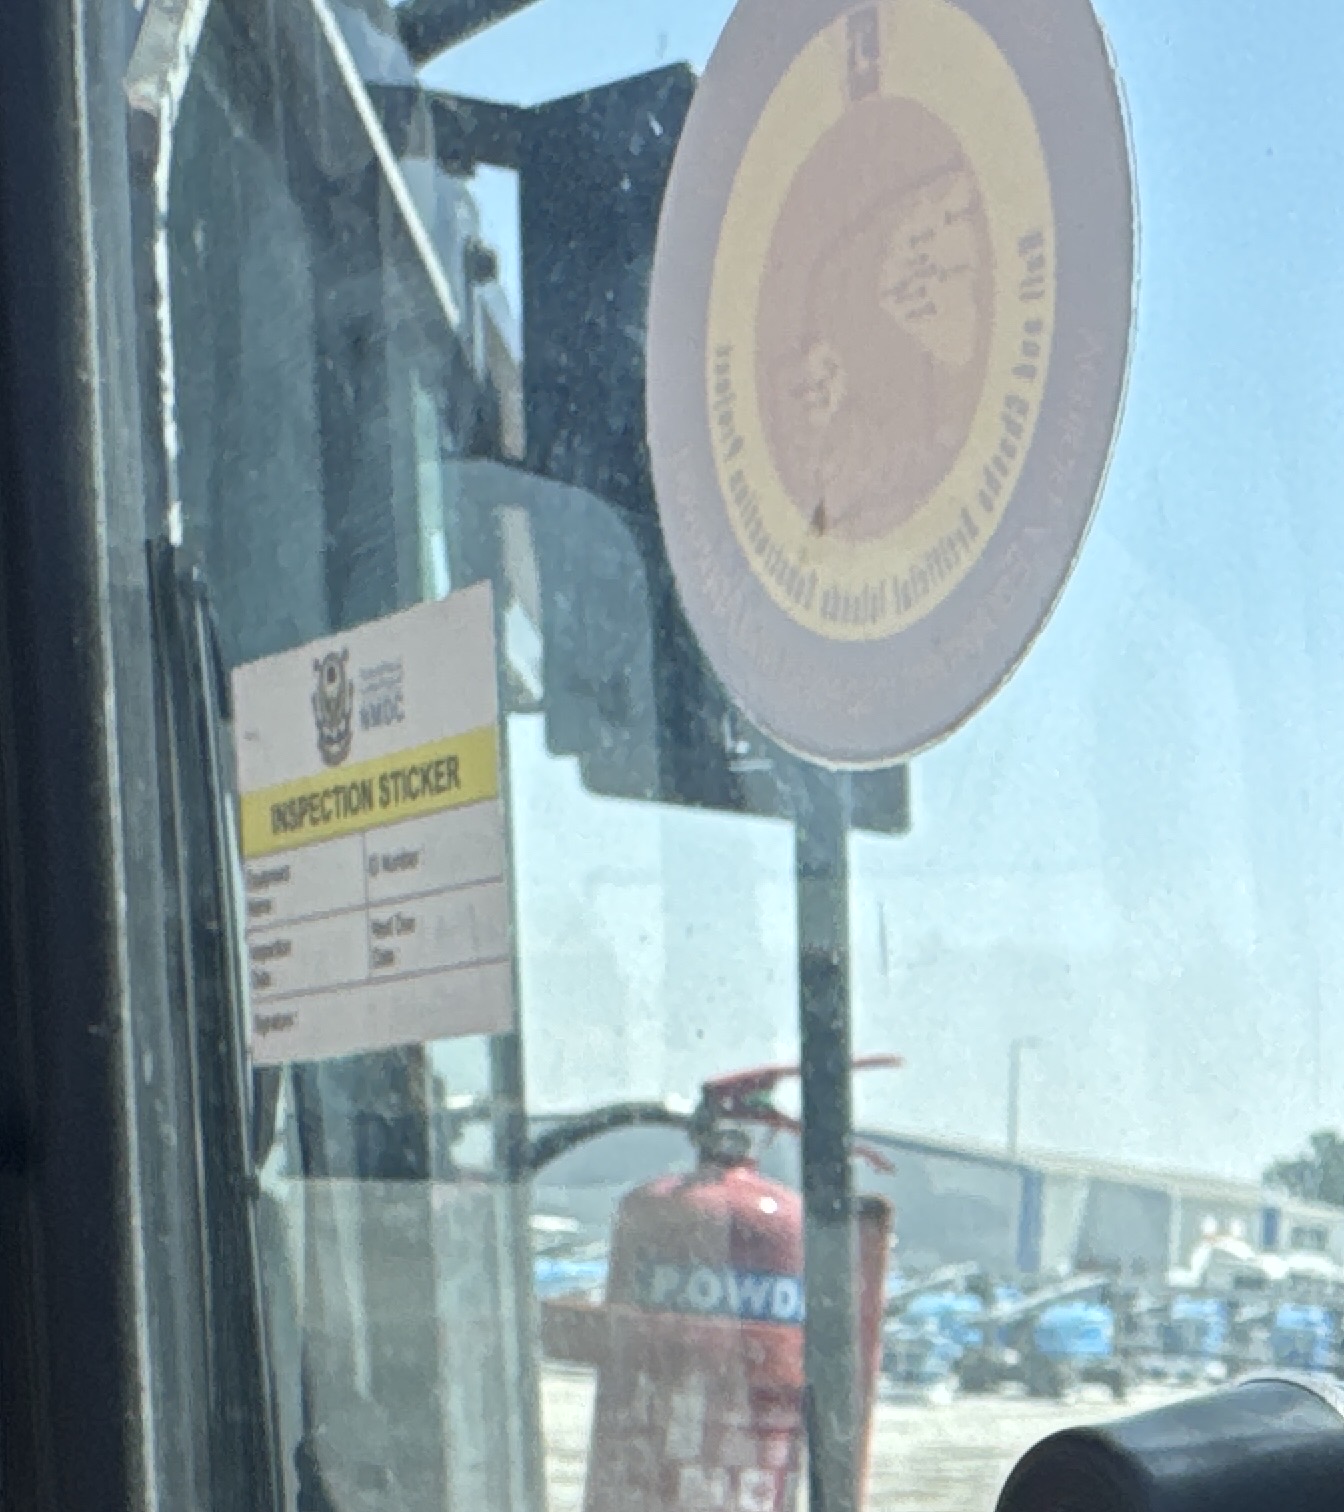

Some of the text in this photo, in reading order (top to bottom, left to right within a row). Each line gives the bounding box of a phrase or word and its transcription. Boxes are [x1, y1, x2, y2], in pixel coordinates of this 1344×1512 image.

[270, 754, 462, 835] INSPECTION STICKER
[652, 1262, 806, 1322] POWD
